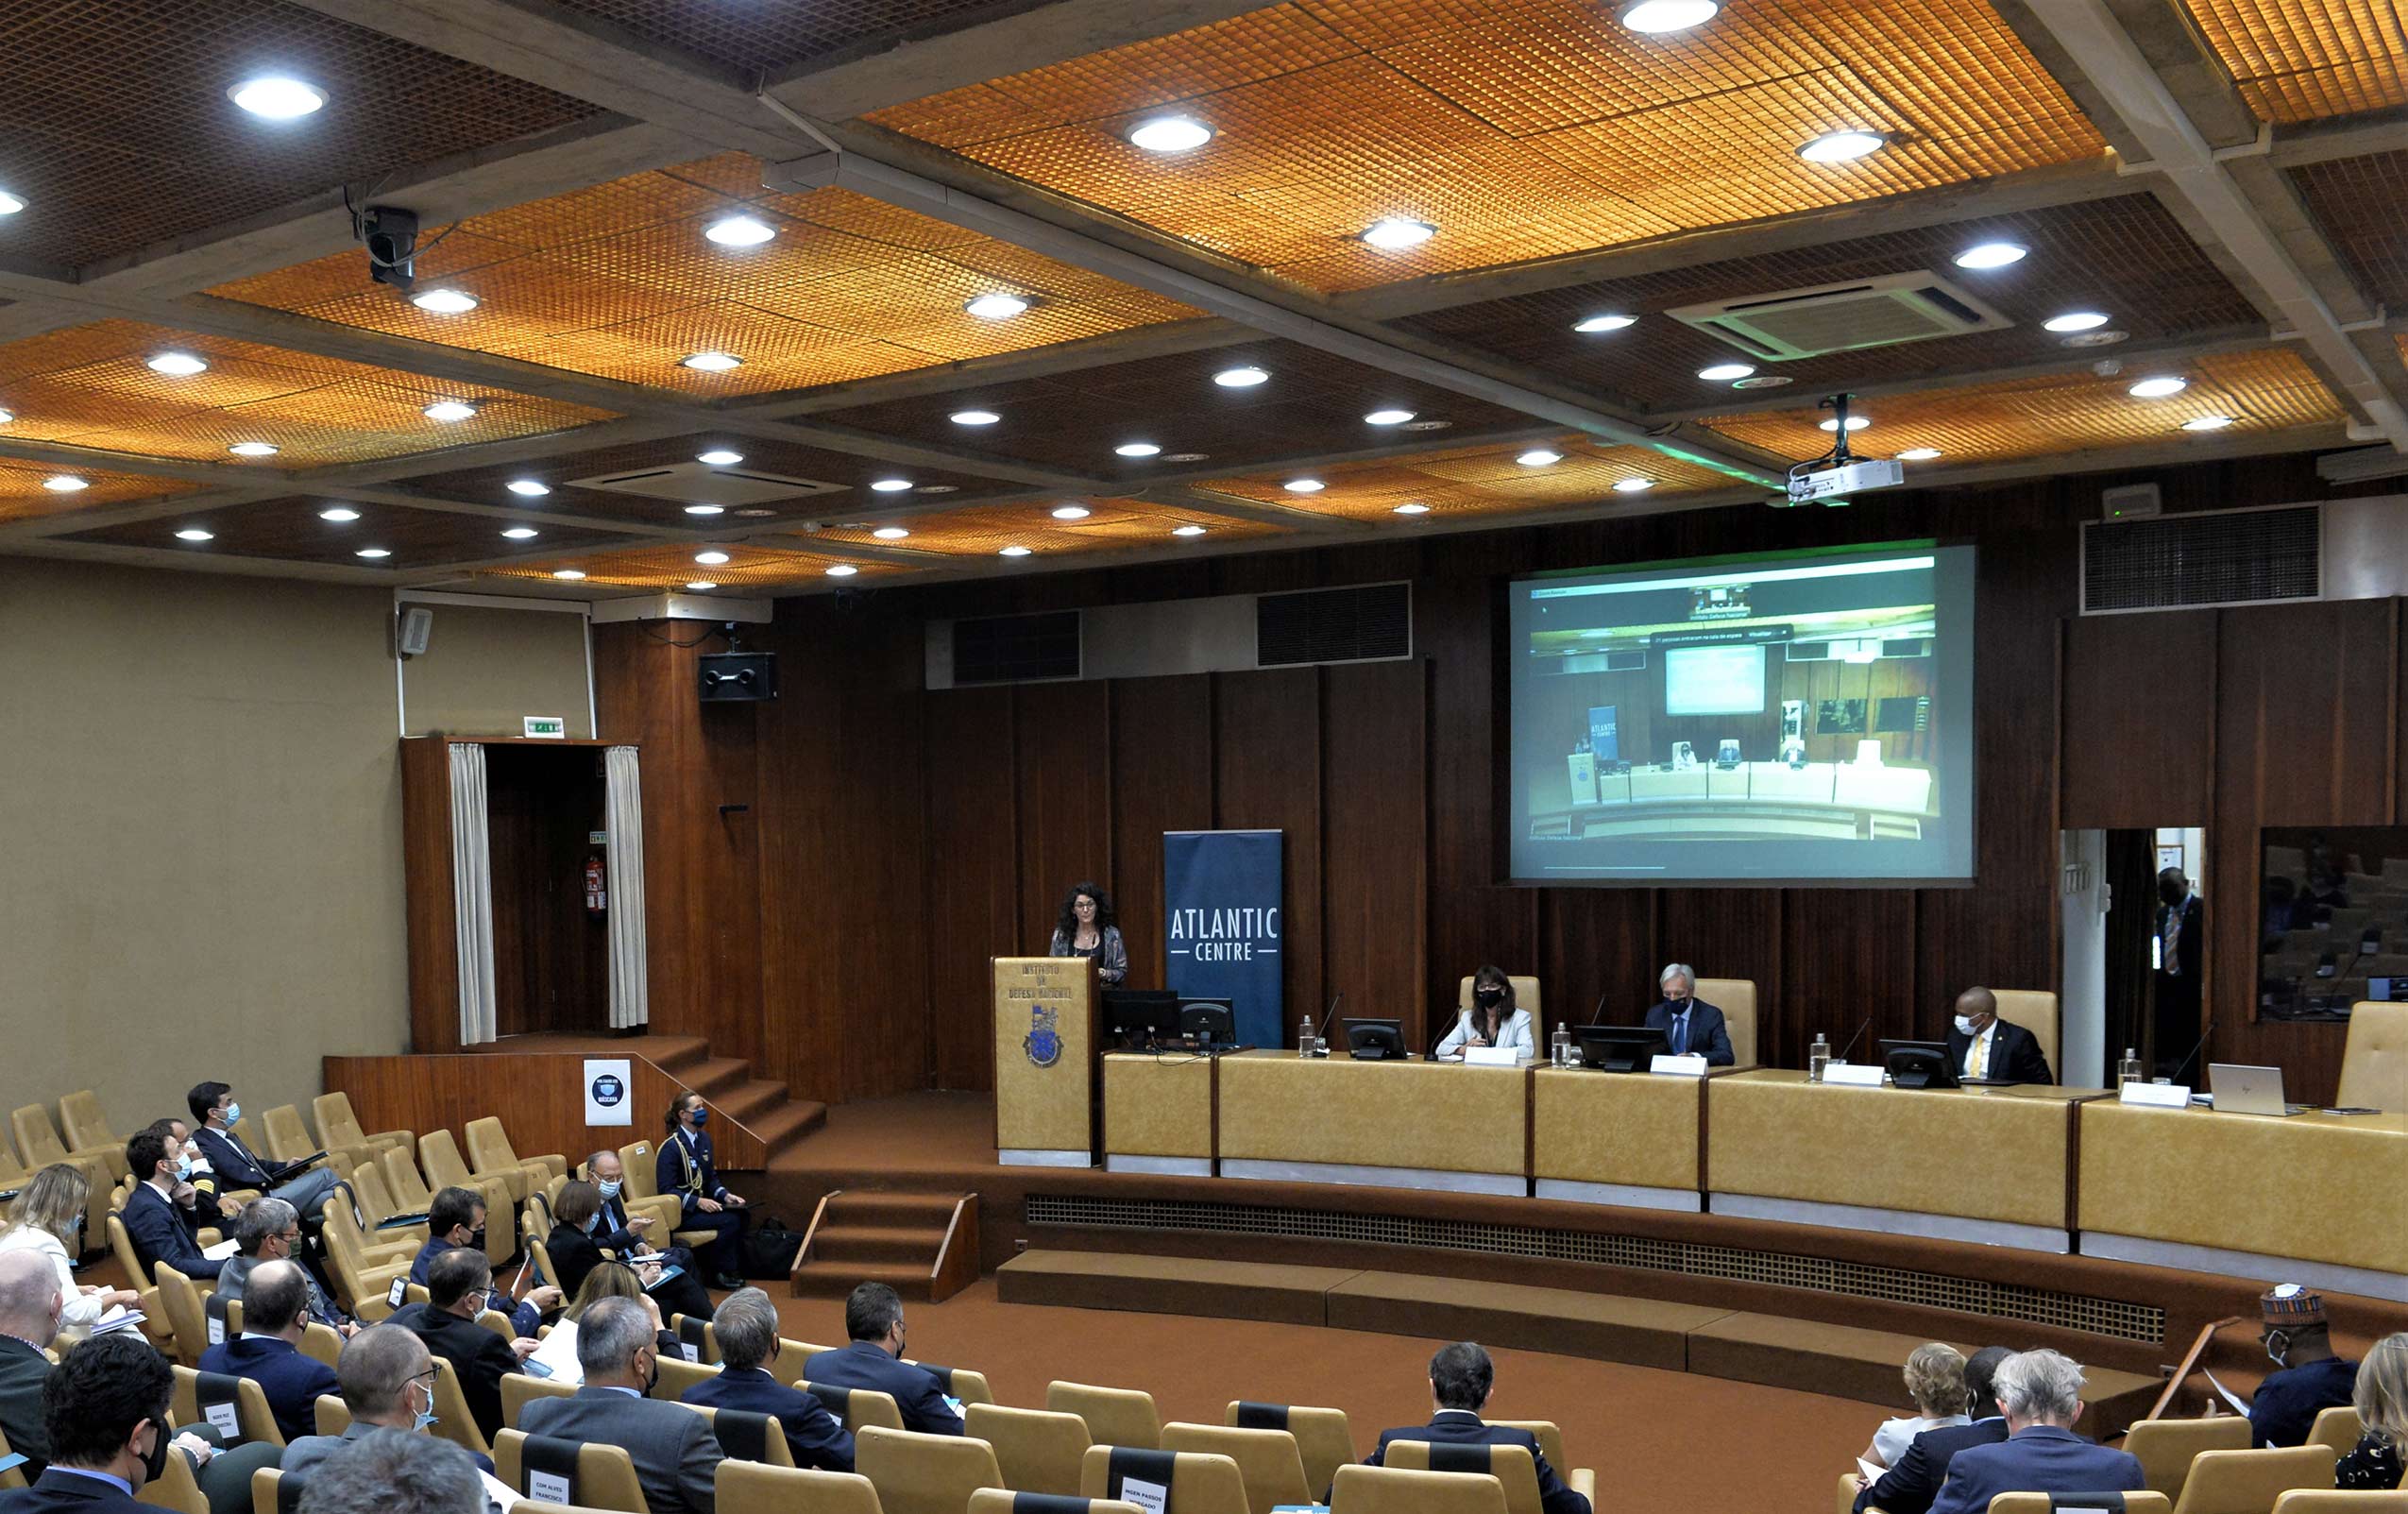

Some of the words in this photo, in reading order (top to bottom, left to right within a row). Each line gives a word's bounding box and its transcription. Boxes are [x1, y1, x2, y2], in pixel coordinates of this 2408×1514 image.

[1171, 908, 1278, 939] ATLANTIC
[1196, 943, 1252, 961] CENTRE
[1022, 964, 1060, 976] INSTITUTO
[1009, 989, 1036, 999] DEFESA
[535, 1491, 563, 1502] FRANCISCO
[1142, 1493, 1162, 1502] PASSOS
